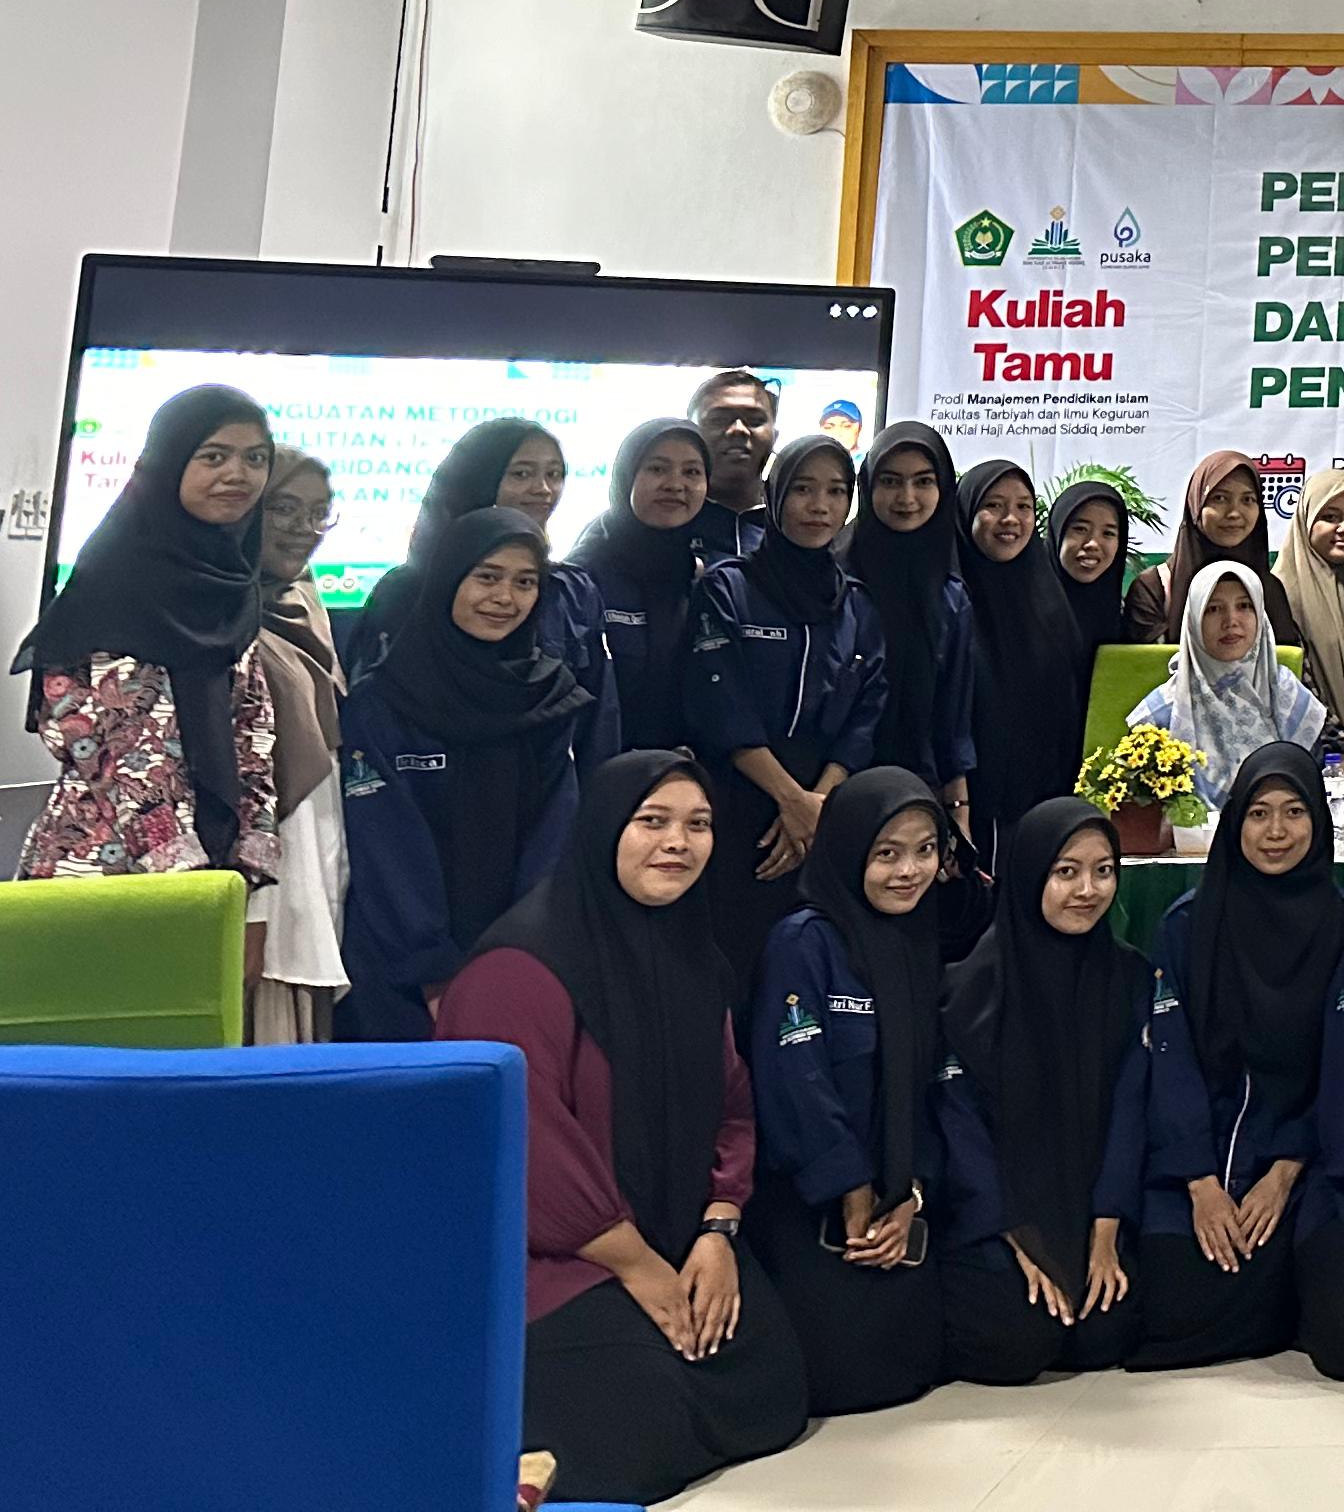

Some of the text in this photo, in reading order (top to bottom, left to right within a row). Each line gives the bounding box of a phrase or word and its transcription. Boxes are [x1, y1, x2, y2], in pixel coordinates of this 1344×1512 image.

[1100, 250, 1151, 267] pusaka
[967, 289, 1126, 329] Kuliah
[973, 343, 1113, 382] Tamu
[933, 393, 1149, 407] Prodi Manajemen Pendidikan Islam
[266, 403, 396, 420] NGUATAN
[931, 408, 1150, 422] Fakultas Tarbiyah dan Ilmu Keguruan
[981, 424, 1003, 438] Haji
[1006, 424, 1056, 436] Achmad
[1060, 424, 1098, 437] Siddiq
[1099, 423, 1146, 435] Jember
